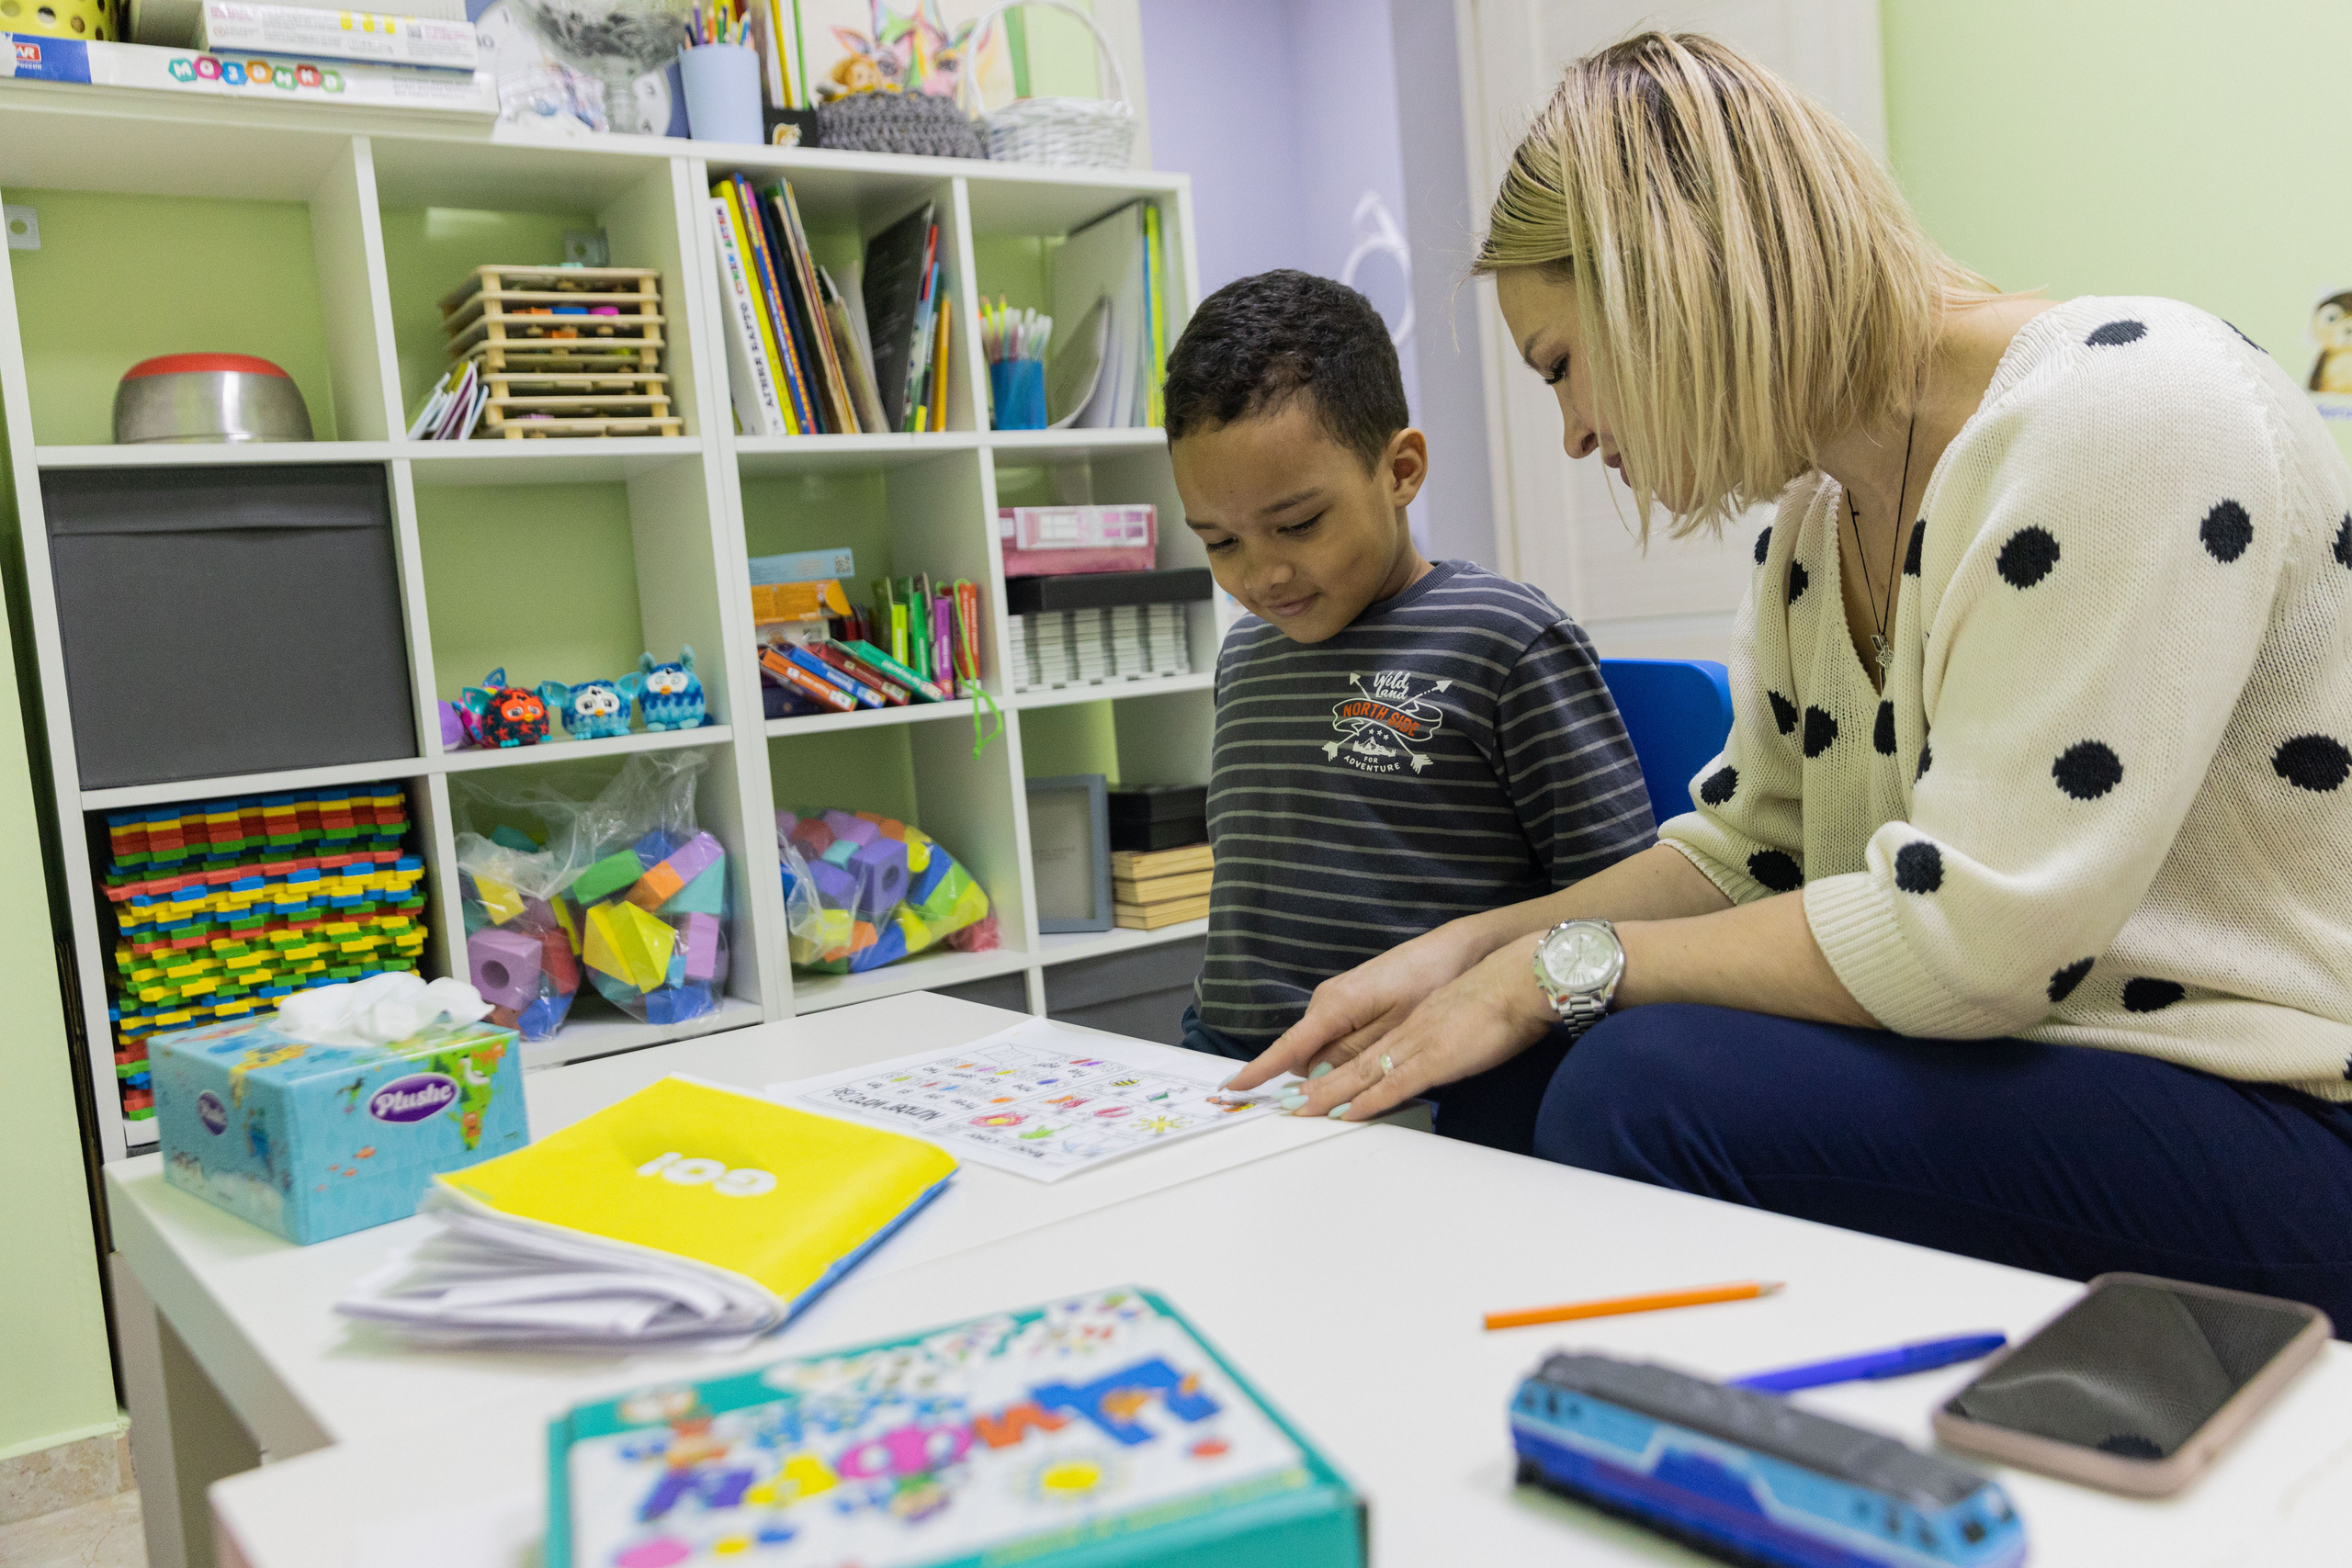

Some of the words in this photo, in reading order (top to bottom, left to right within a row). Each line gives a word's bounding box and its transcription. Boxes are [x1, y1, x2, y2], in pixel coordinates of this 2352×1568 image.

[741, 301, 761, 352] БАРТО
[753, 355, 775, 409] АГНИЯ
[1373, 671, 1411, 690] Wild
[1374, 685, 1410, 700] Land
[1342, 702, 1390, 721] NORTH
[1386, 712, 1421, 738] SIDE
[1343, 755, 1401, 773] ADVENTURE
[1363, 756, 1378, 764] FOR
[375, 1083, 453, 1118] Plushe
[881, 1103, 946, 1122] Number
